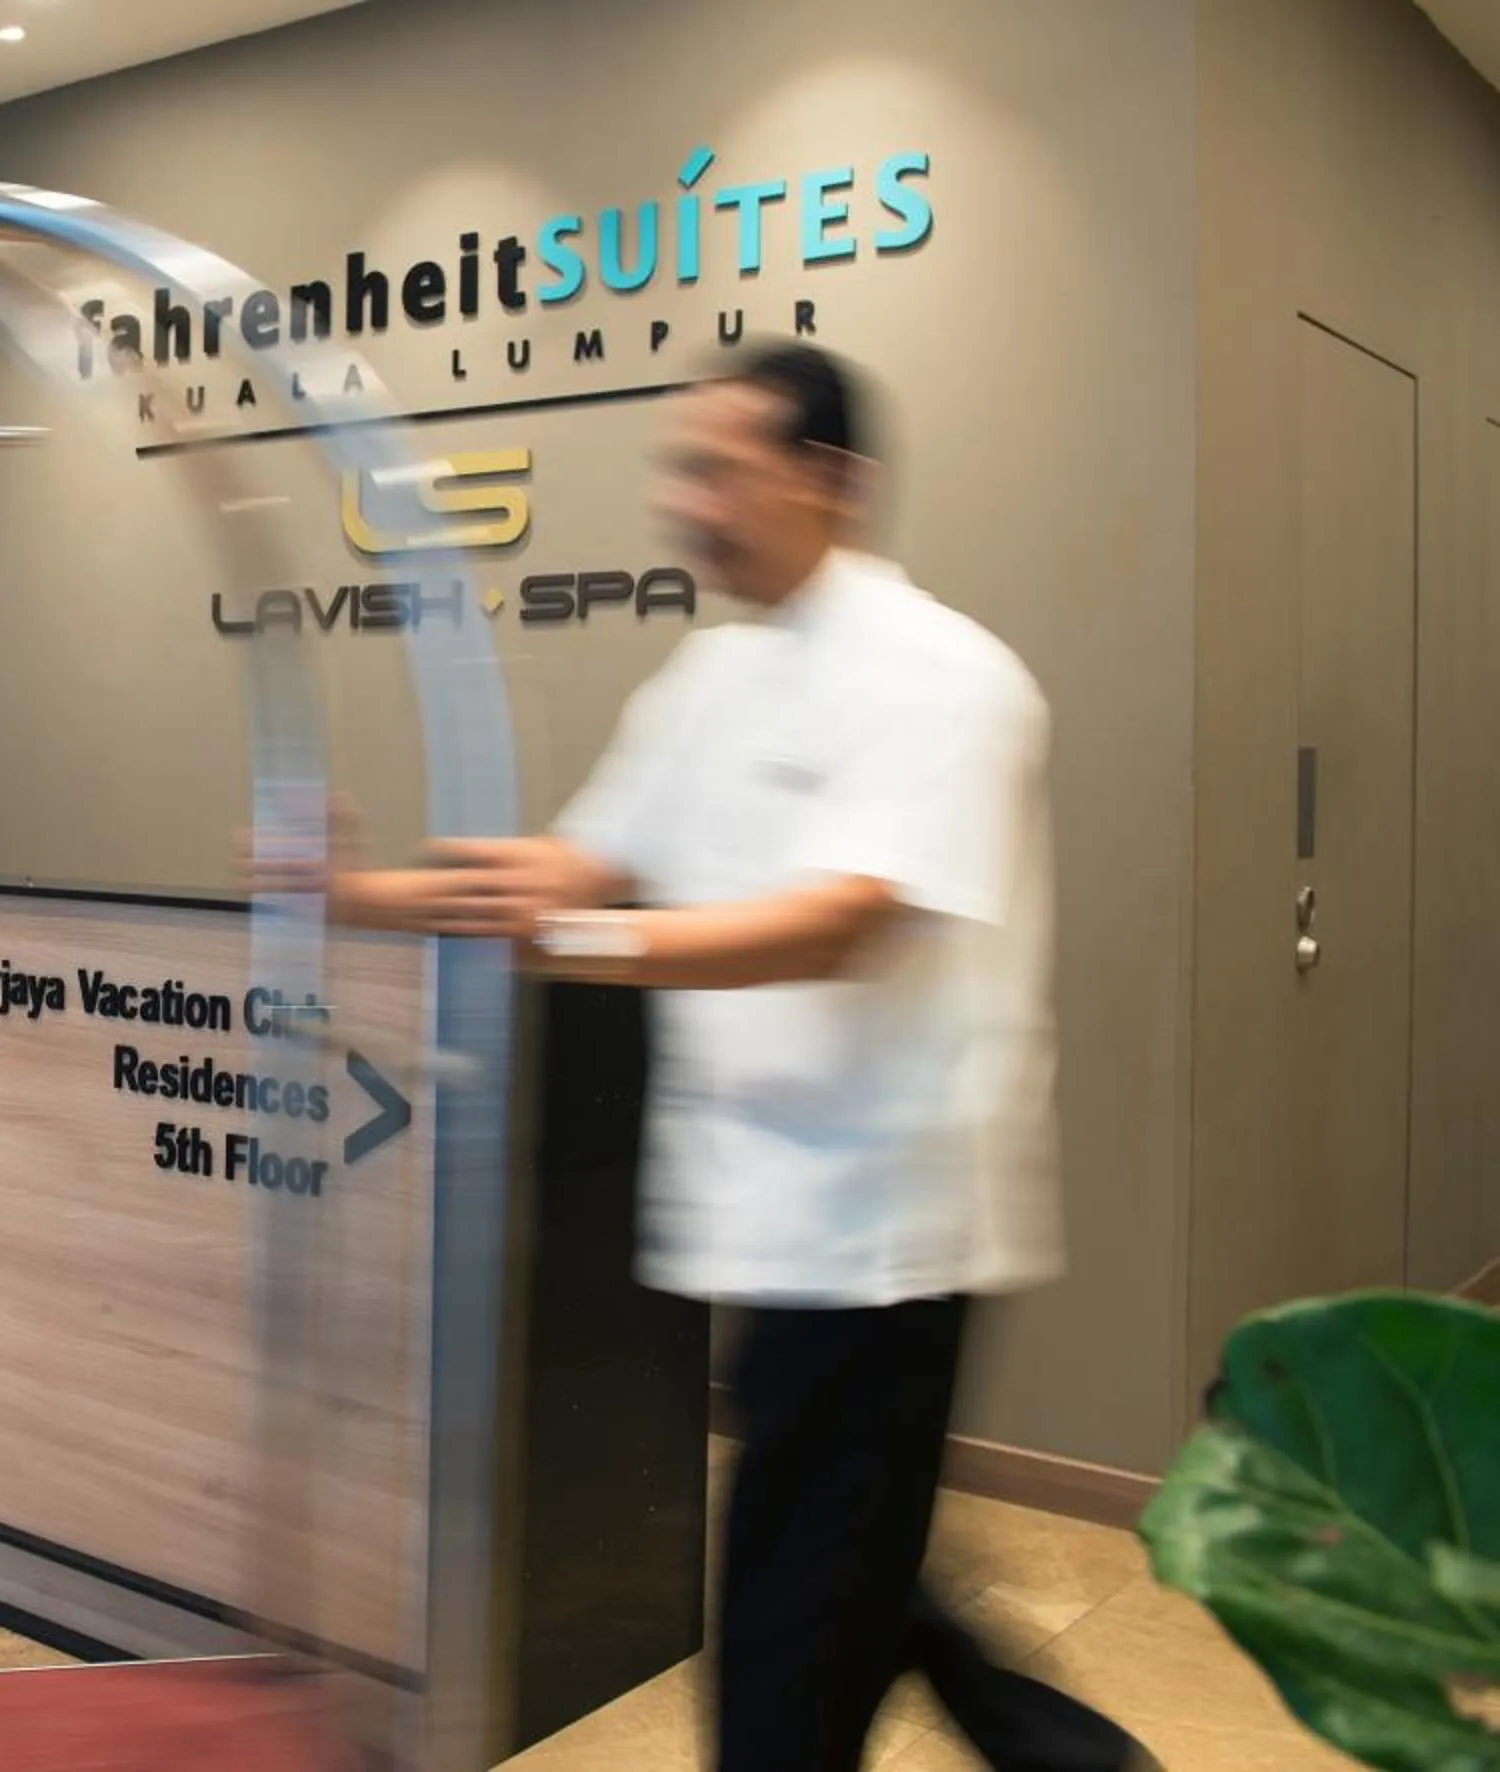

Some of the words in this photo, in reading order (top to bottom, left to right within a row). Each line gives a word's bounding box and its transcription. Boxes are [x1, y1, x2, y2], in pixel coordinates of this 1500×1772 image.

[137, 362, 365, 422] KUALA
[452, 300, 816, 378] LUMPUR
[212, 579, 463, 635] LAVISH
[519, 566, 696, 624] SPA
[77, 968, 231, 1031] Vacation
[113, 1043, 330, 1122] Residences
[153, 1122, 212, 1177] 5th
[225, 1133, 329, 1197] Floor
